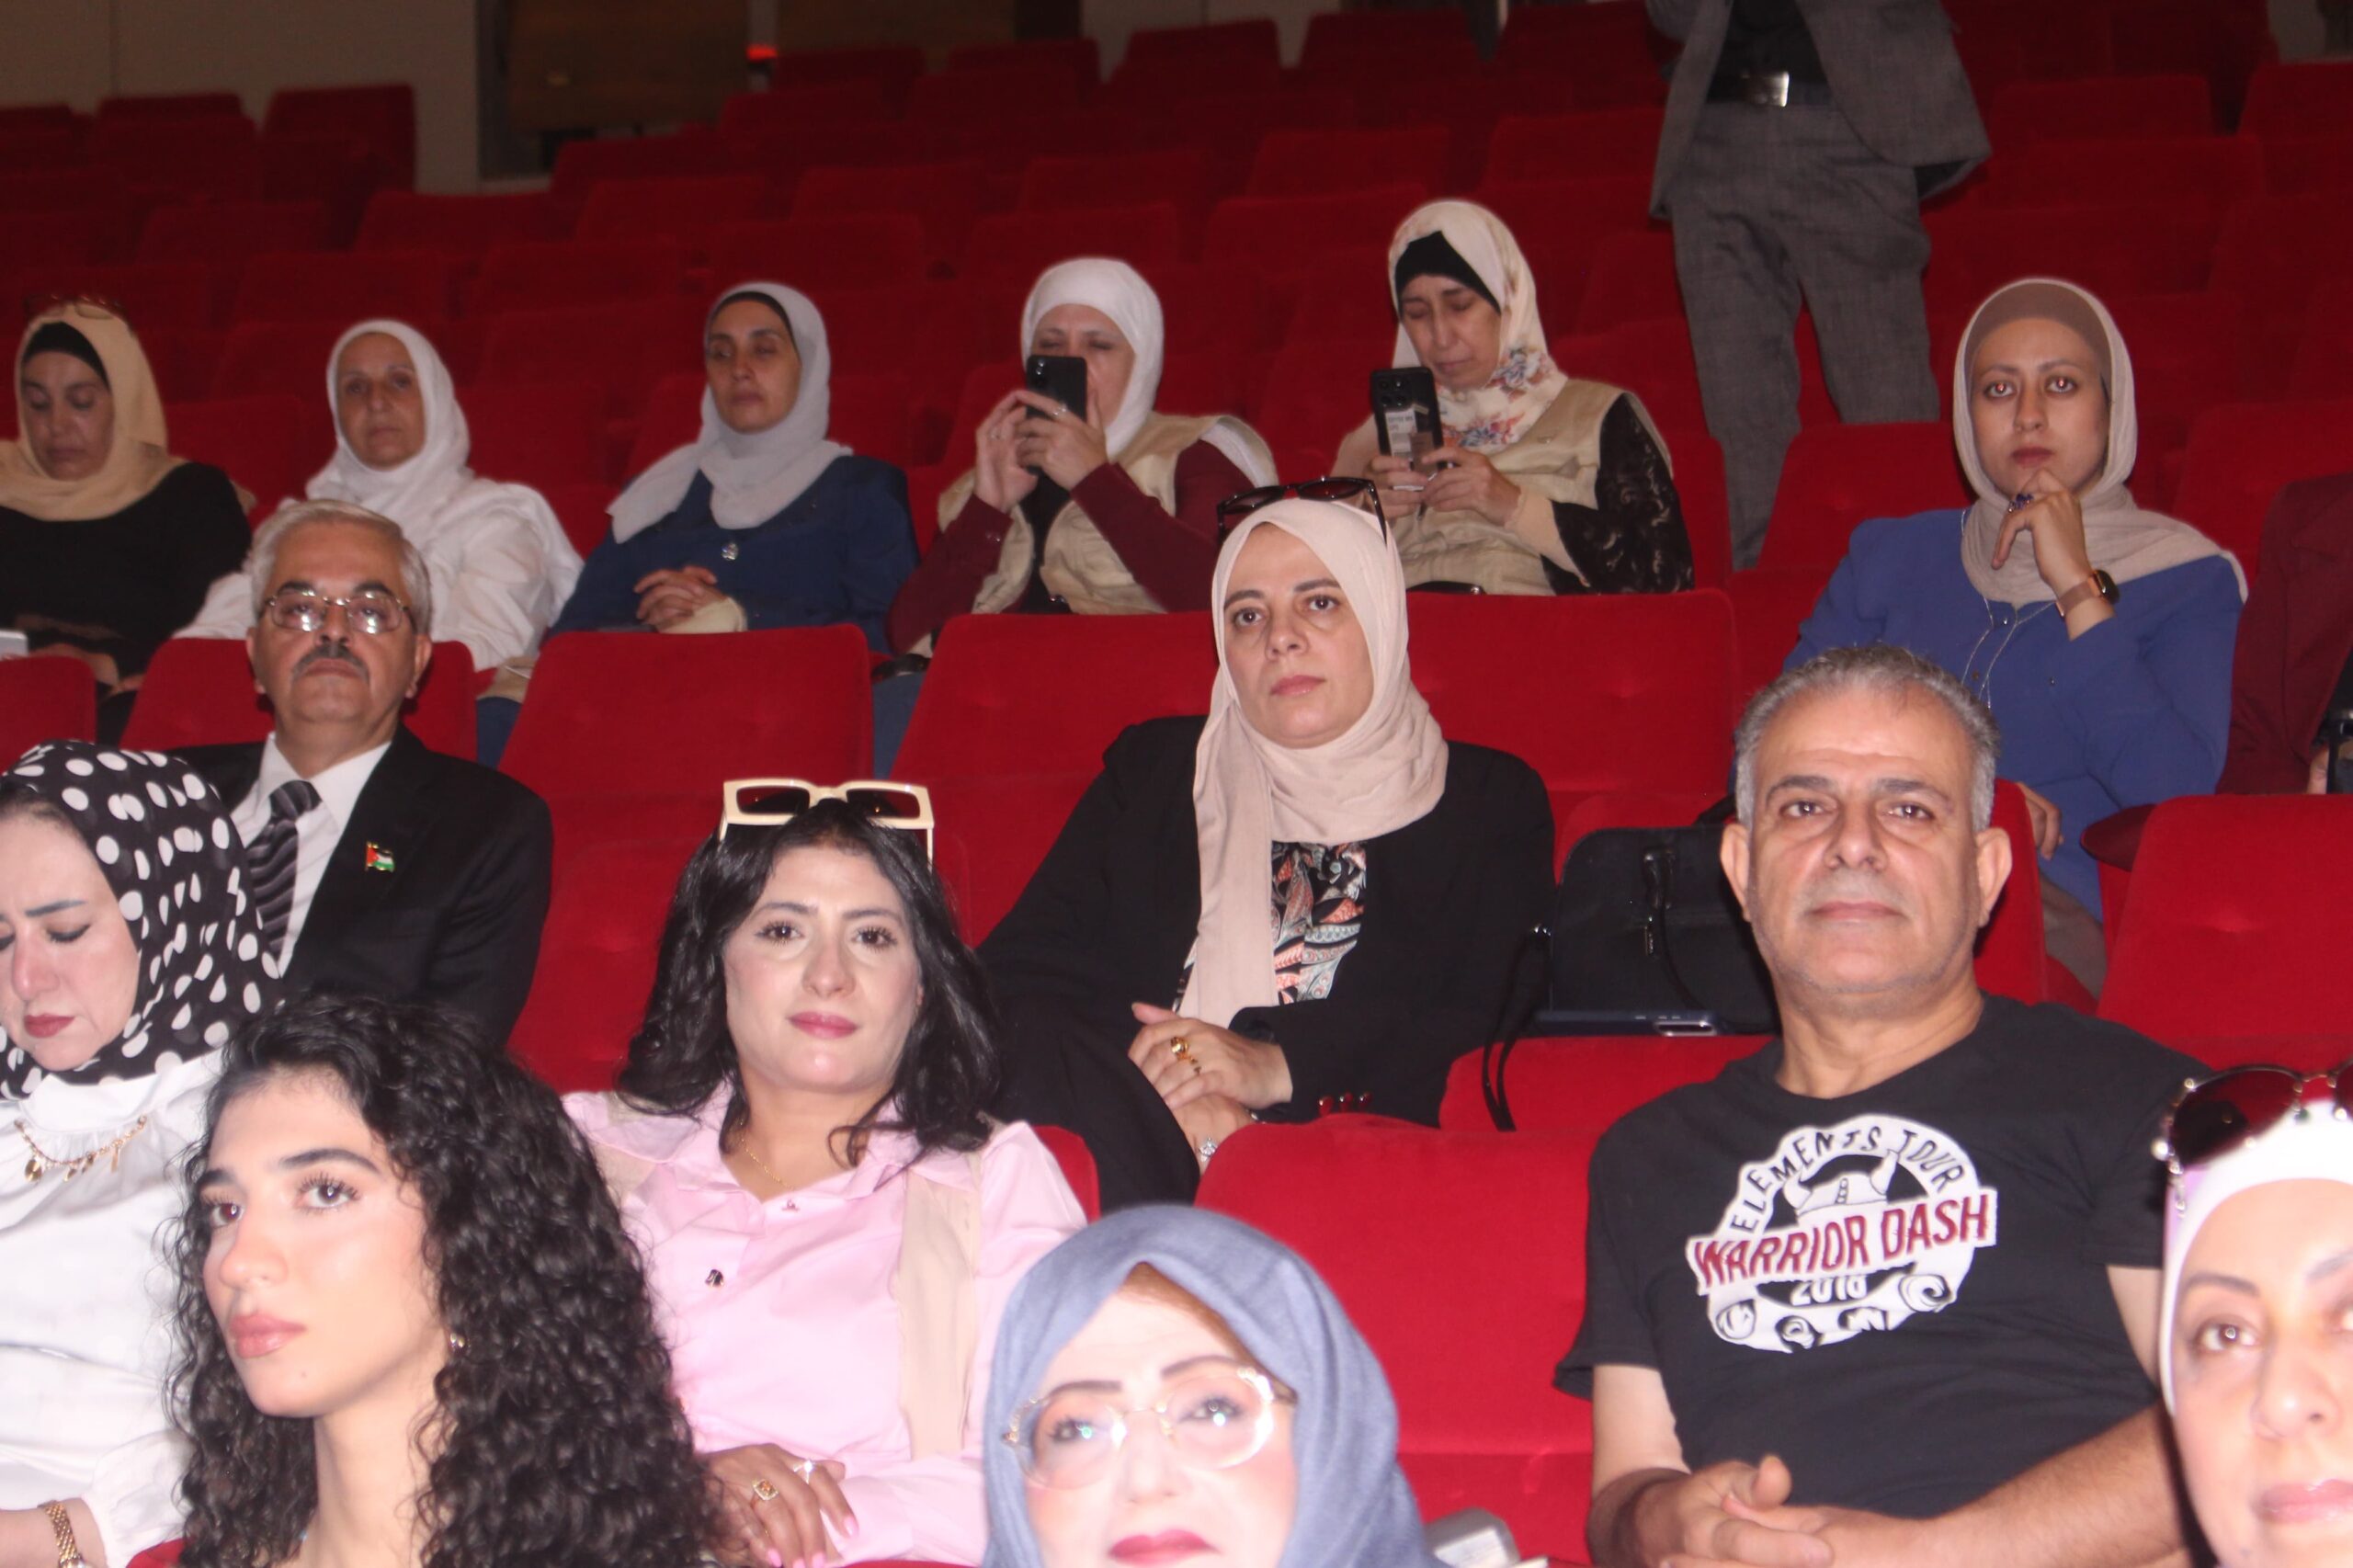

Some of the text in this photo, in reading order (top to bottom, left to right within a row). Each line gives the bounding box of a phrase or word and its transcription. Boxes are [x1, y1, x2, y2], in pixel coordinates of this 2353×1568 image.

[1730, 1126, 1966, 1233] ELEMENTS TOUR
[1693, 1194, 1989, 1289] WARRIOR DASH
